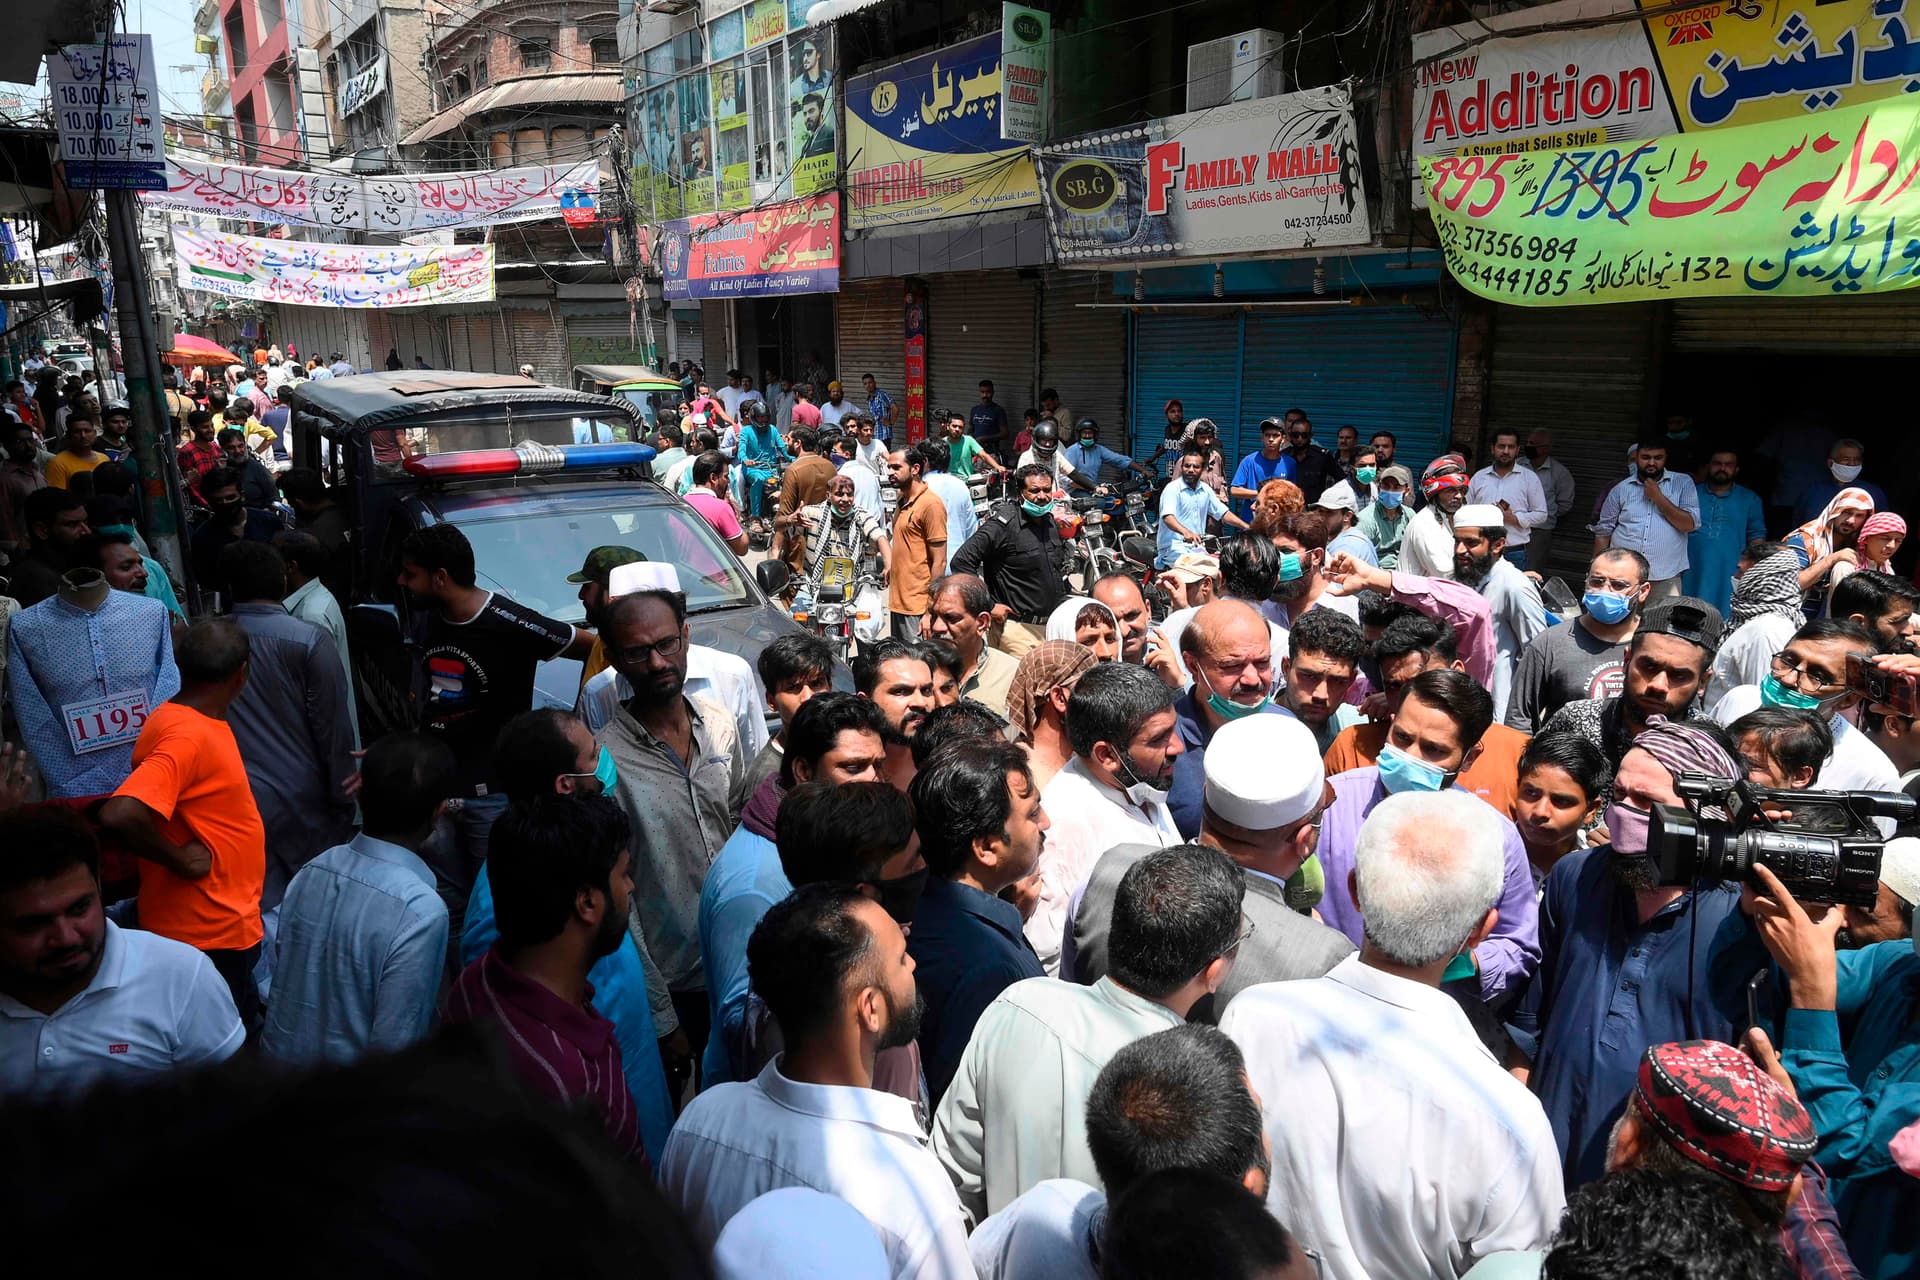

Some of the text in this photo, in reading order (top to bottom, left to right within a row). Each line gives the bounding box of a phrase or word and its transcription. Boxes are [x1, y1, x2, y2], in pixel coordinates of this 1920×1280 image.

[1664, 5, 1720, 27] OXFORD
[1422, 54, 1479, 87] New
[61, 86, 110, 106] 18,000
[1009, 85, 1039, 105] MALL
[1423, 62, 1653, 142] Addition
[64, 112, 113, 132] 10,000
[901, 111, 920, 139] شوز
[68, 137, 116, 157] 70,000
[1473, 147, 1502, 155] Store
[1506, 140, 1529, 153] that
[1533, 136, 1562, 150] Sells
[1567, 131, 1598, 146] Style
[803, 159, 829, 171] HAIR
[812, 171, 836, 182] LAIR
[1645, 148, 1677, 182] اب
[1648, 134, 1808, 219] سوٹ
[852, 160, 964, 209] IMPERIAL SHOES
[1065, 176, 1105, 198] SB.G
[1147, 141, 1341, 215] FAMILY MALL
[1528, 145, 1660, 222] 1395
[1275, 189, 1287, 200] all
[1290, 182, 1345, 200] Garments
[331, 198, 359, 225] موقع
[1284, 213, 1351, 230] 042-37234500
[224, 240, 254, 267] چکن
[704, 252, 746, 275] Fabrics
[709, 274, 810, 291] All Kind Of Ladies Fancy Variety
[73, 703, 147, 741] 1195
